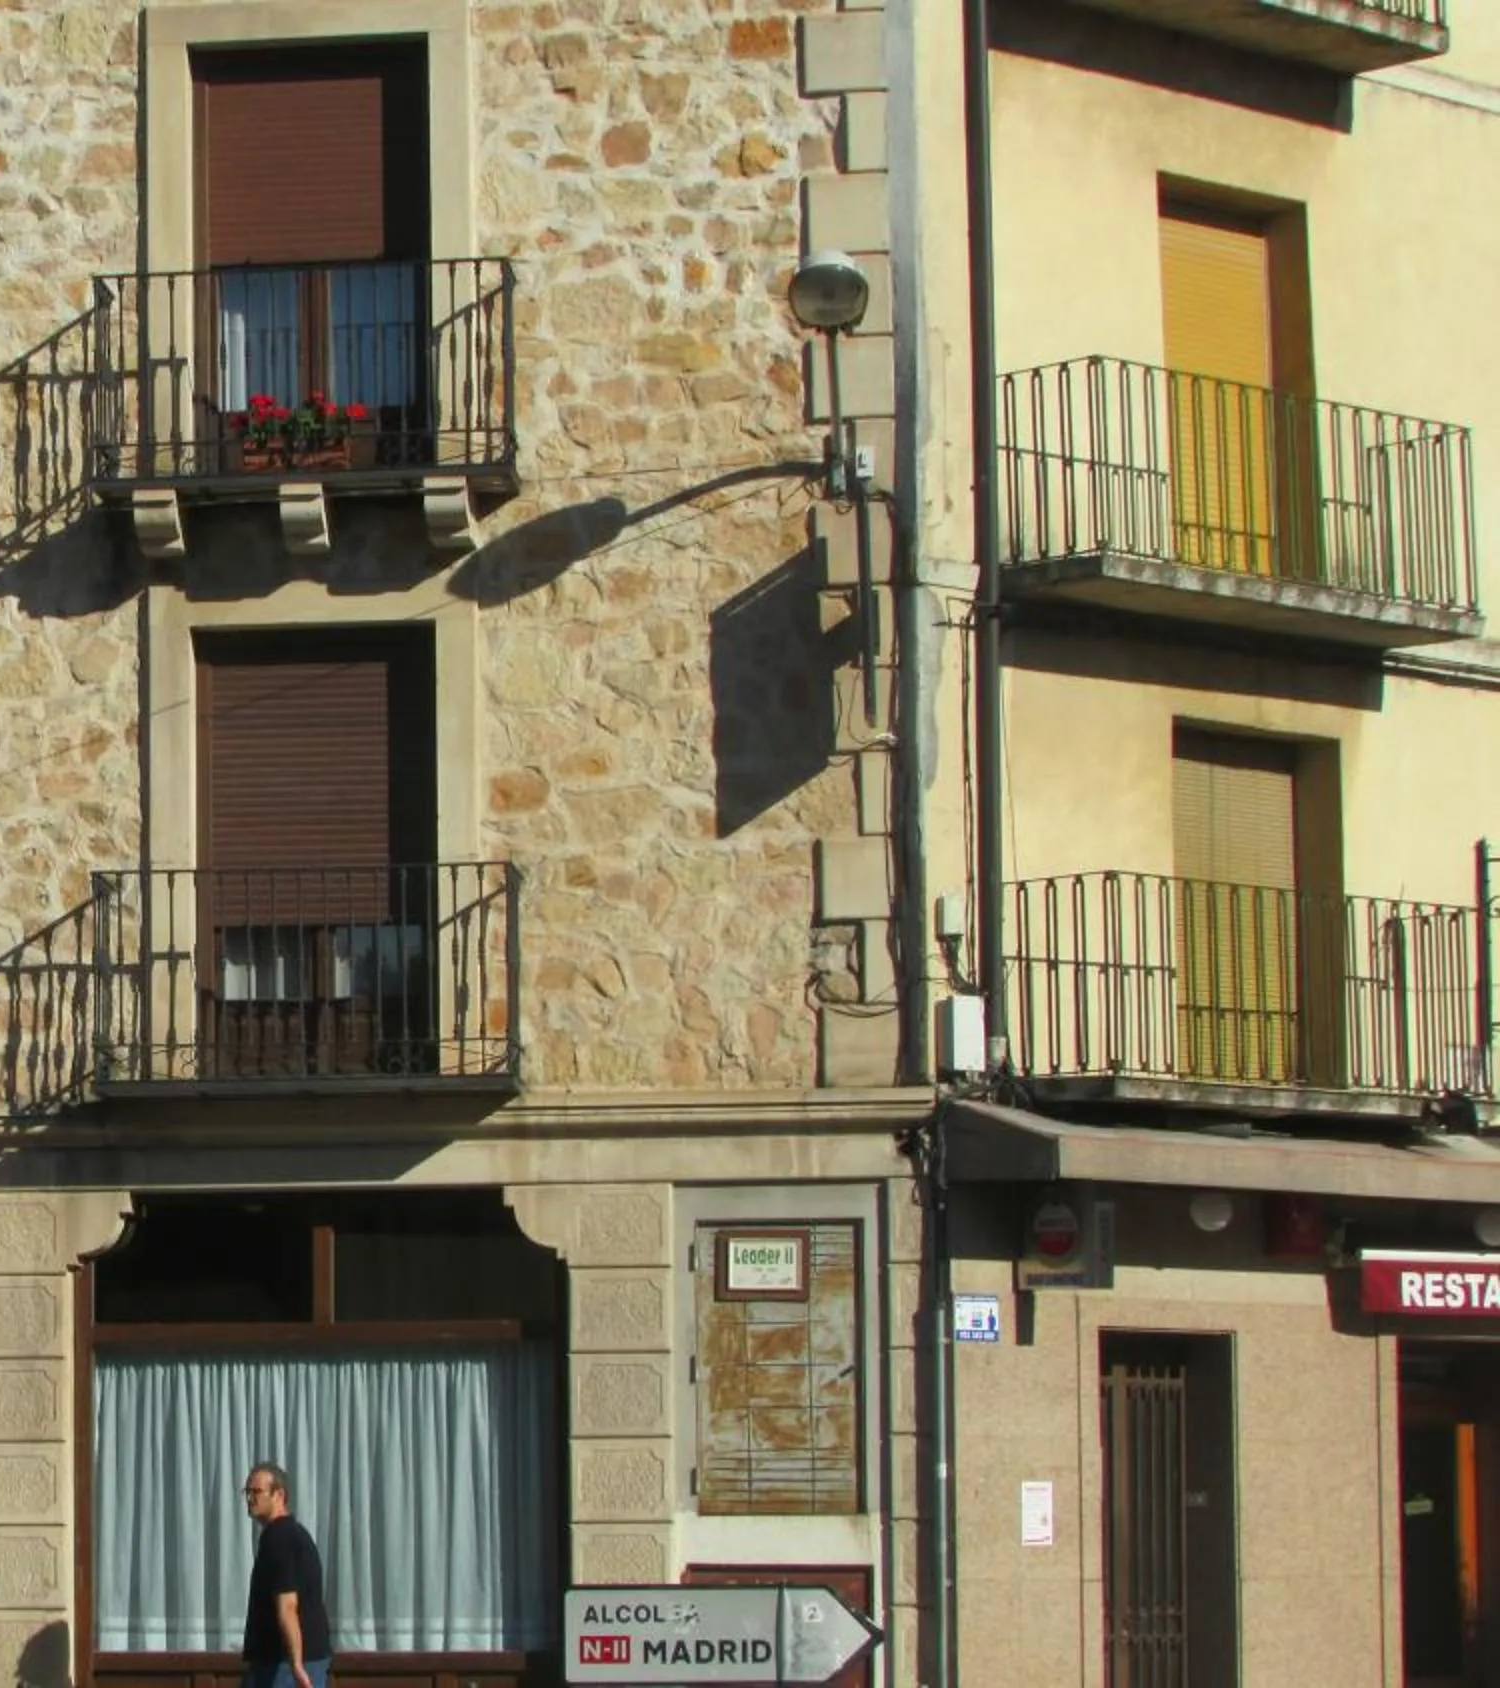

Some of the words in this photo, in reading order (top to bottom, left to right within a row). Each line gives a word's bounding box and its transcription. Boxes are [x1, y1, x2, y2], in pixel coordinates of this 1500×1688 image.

[733, 1246, 782, 1265] Leader
[1400, 1271, 1500, 1309] RESTA
[643, 1639, 773, 1664] MADRID
